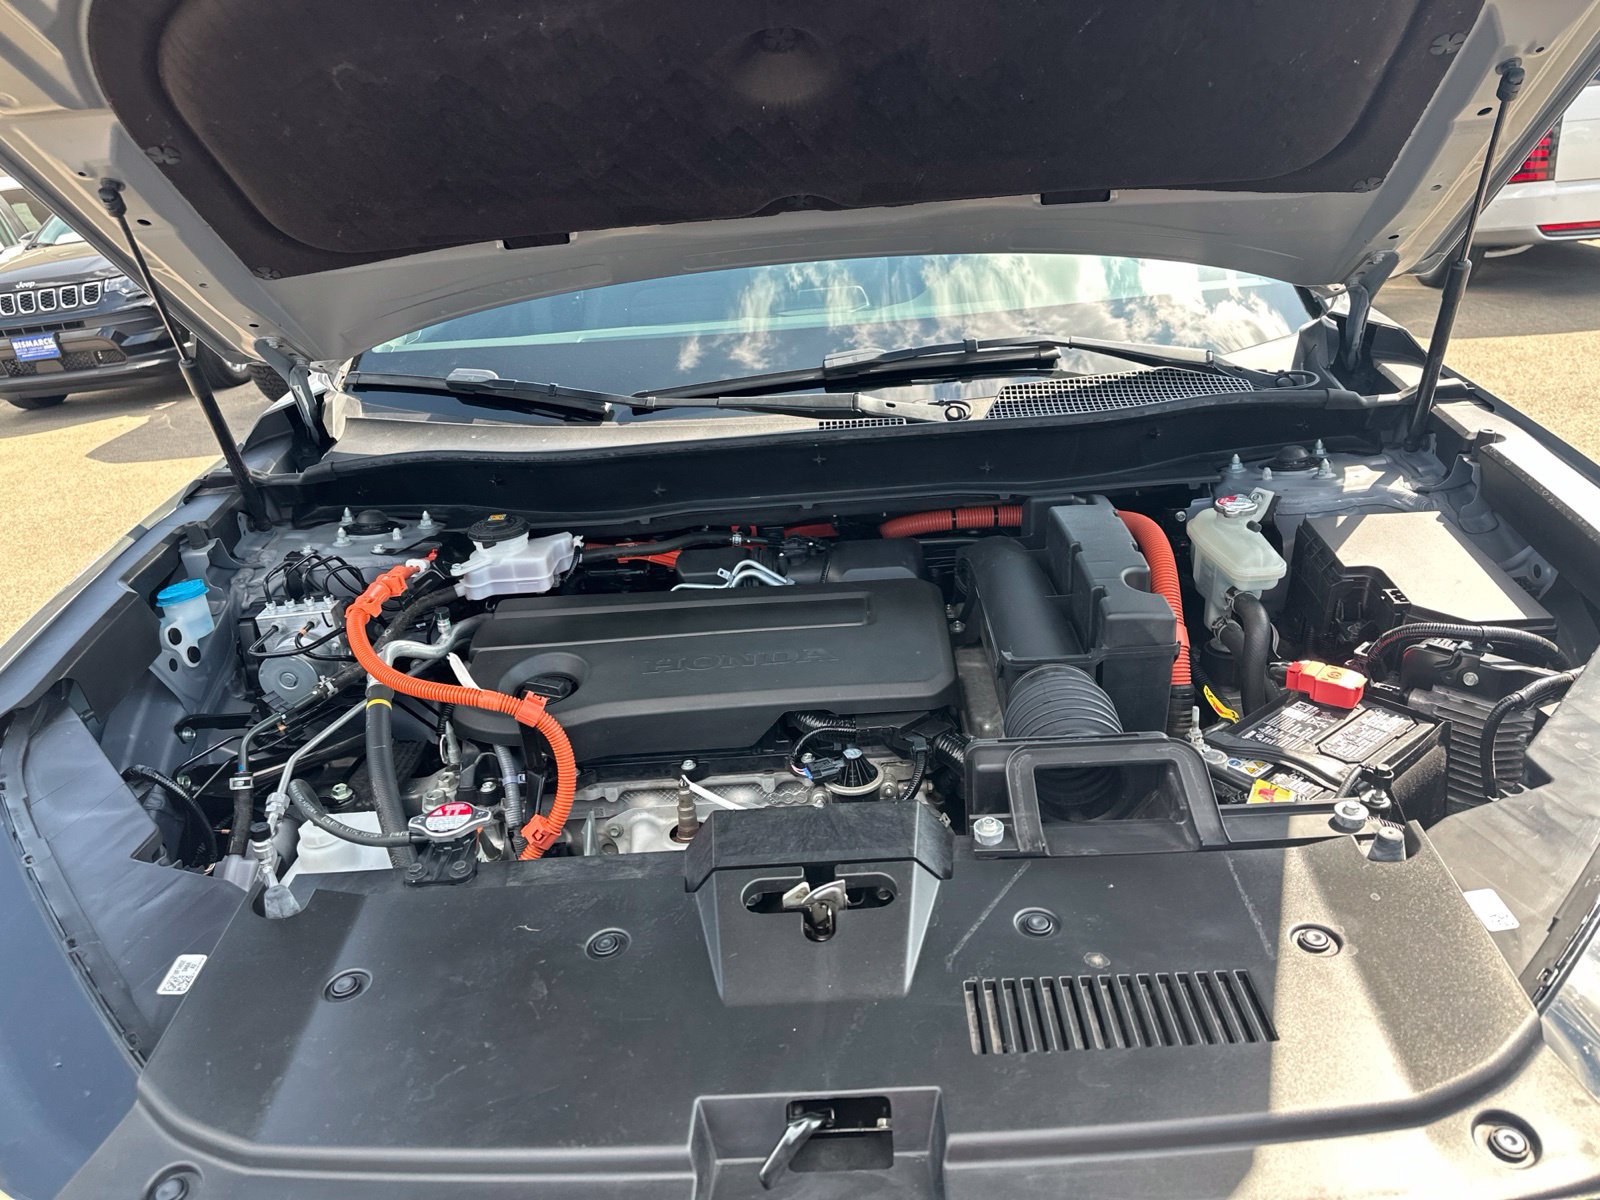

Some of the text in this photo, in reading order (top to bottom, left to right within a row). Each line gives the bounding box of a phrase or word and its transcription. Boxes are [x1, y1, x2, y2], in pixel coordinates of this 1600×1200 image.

[15, 281, 35, 289] Jeep
[12, 337, 54, 349] BISMARCK
[641, 648, 839, 675] HONDA
